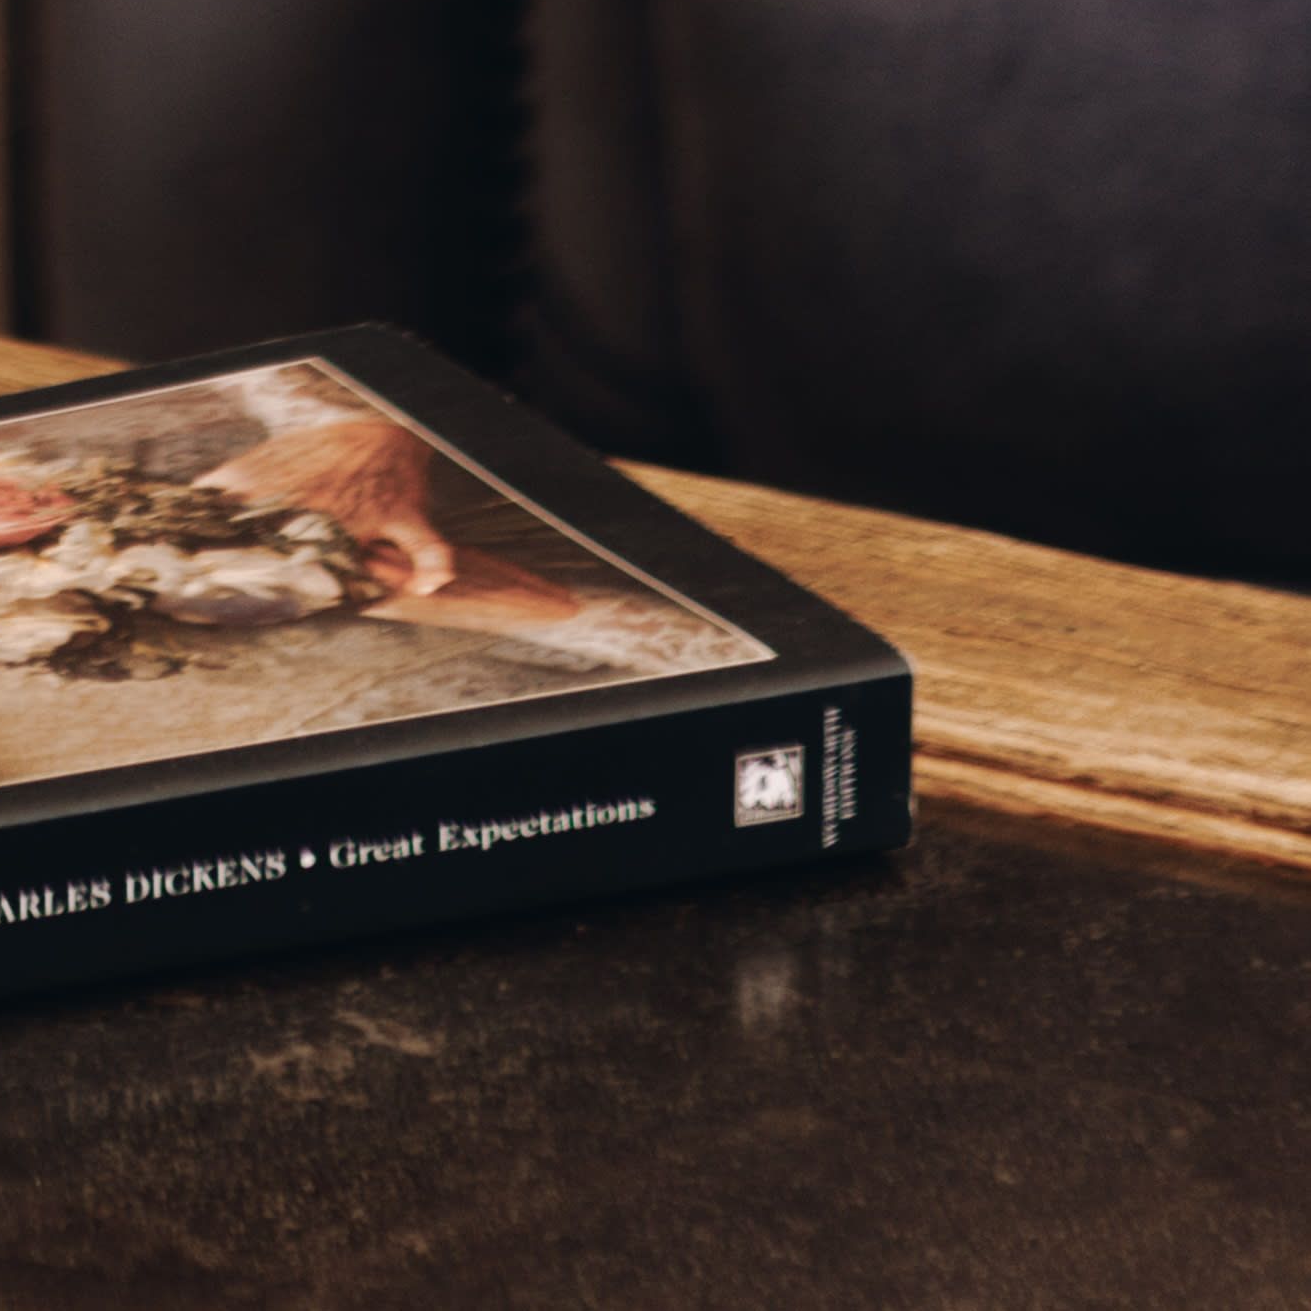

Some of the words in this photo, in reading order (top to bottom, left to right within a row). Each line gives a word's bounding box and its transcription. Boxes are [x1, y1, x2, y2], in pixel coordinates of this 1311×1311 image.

[124, 849, 287, 904] DICKENS
[328, 833, 424, 869] Great
[438, 796, 657, 852] Expectations
